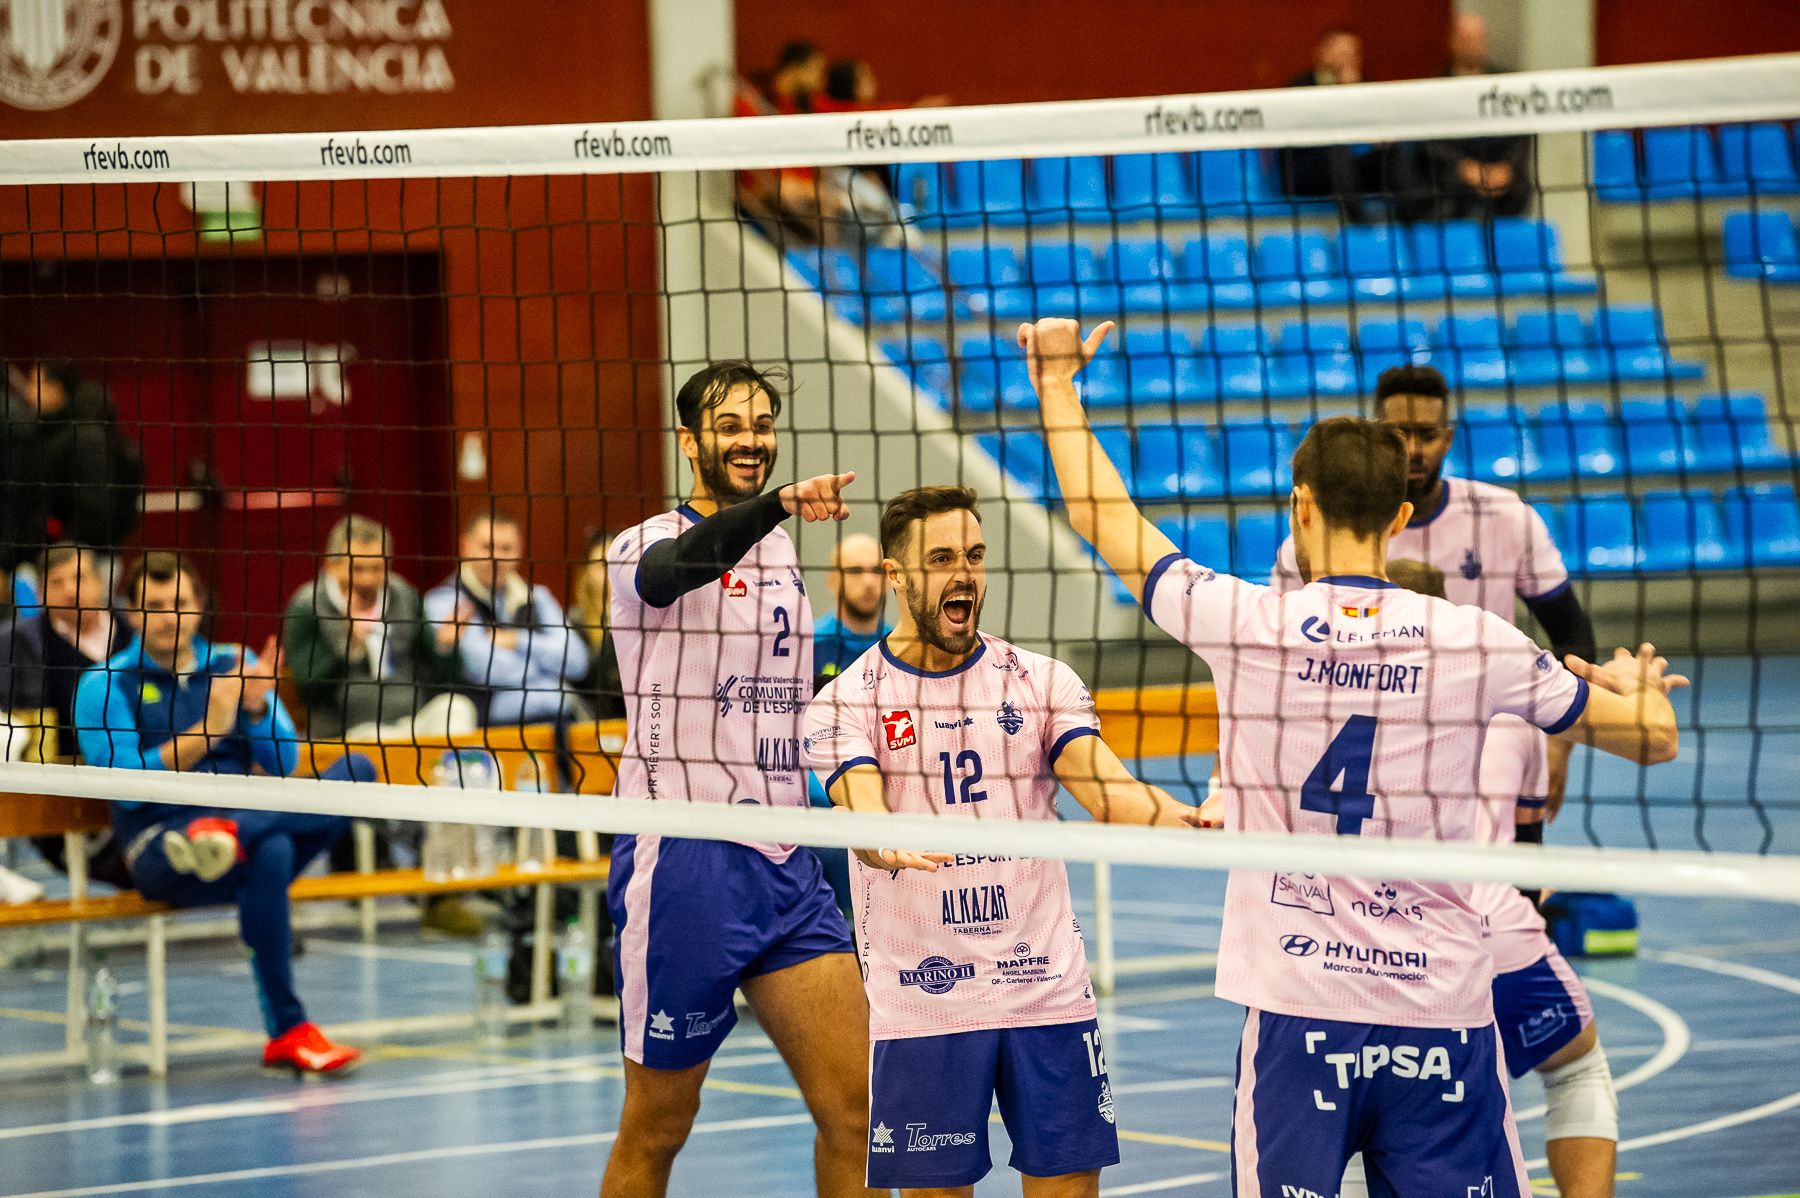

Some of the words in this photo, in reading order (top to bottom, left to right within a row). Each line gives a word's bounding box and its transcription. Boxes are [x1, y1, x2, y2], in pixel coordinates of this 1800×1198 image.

[135, 44, 200, 95] DE
[1479, 84, 1614, 117] rfevb.com
[1145, 105, 1265, 134] rfevb.com
[574, 131, 671, 158] rfevb.com
[846, 120, 952, 150] rfevb.com
[84, 144, 170, 170] rfevb.com
[321, 140, 411, 165] rfevb.com
[773, 606, 790, 657] 2
[1298, 657, 1423, 694] J.MONFORT
[651, 683, 662, 719] SOHN
[739, 686, 803, 700] COMUNITAT
[743, 701, 760, 714] DE
[934, 719, 962, 730] luanvi
[649, 723, 660, 773] MEYER'S
[890, 735, 914, 750] SVM
[939, 750, 988, 805] 12
[1300, 714, 1377, 835] 4
[942, 884, 1009, 925] ALKAZAR
[954, 926, 991, 934] TABERNA
[996, 956, 1050, 969] MAPFRE
[1323, 962, 1363, 974] Marcos
[1326, 941, 1427, 968] HYUNDAI
[903, 968, 957, 983] MARINO
[961, 967, 971, 978] II
[1083, 1028, 1107, 1077] 12
[1325, 1044, 1451, 1090] TIPSA
[872, 1145, 895, 1153] luanvi
[906, 1123, 976, 1148] Torres
